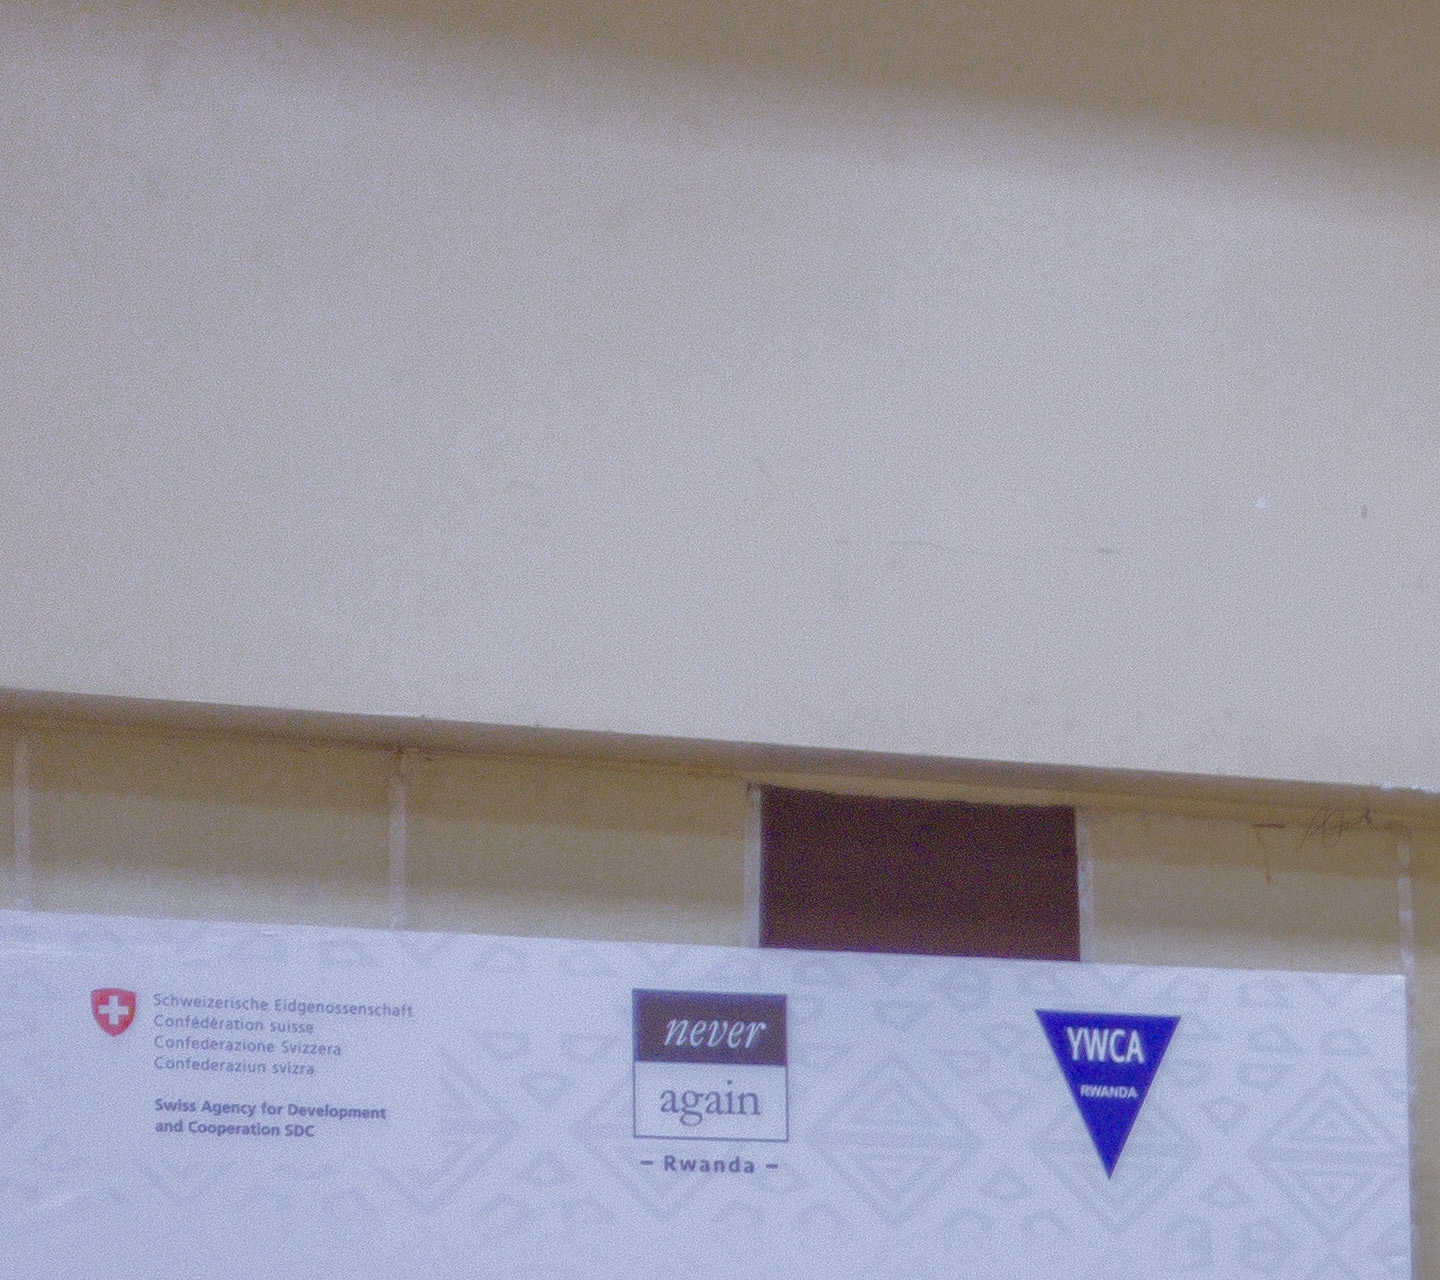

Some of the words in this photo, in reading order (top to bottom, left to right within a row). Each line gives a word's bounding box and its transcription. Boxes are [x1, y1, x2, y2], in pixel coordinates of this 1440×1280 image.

[153, 993, 269, 1013] Schweizerische
[274, 998, 413, 1018] Eidgenossenschaft
[270, 1020, 314, 1034] suisse
[663, 1018, 767, 1049] never
[154, 1034, 275, 1053] Confederazione
[280, 1040, 342, 1056] Svizzera
[1066, 1026, 1146, 1064] YWCA
[154, 1055, 266, 1073] Confederaziun
[271, 1061, 315, 1075] svizra
[1079, 1084, 1139, 1099] RWANDA
[155, 1098, 196, 1113] Swiss
[200, 1100, 257, 1117] Agency
[261, 1101, 283, 1116] for
[287, 1103, 387, 1120] Development
[660, 1079, 762, 1127] again
[155, 1119, 184, 1133] and
[188, 1120, 281, 1137] Cooperation
[284, 1124, 315, 1138] SDC
[663, 1154, 755, 1174] Rwanda
